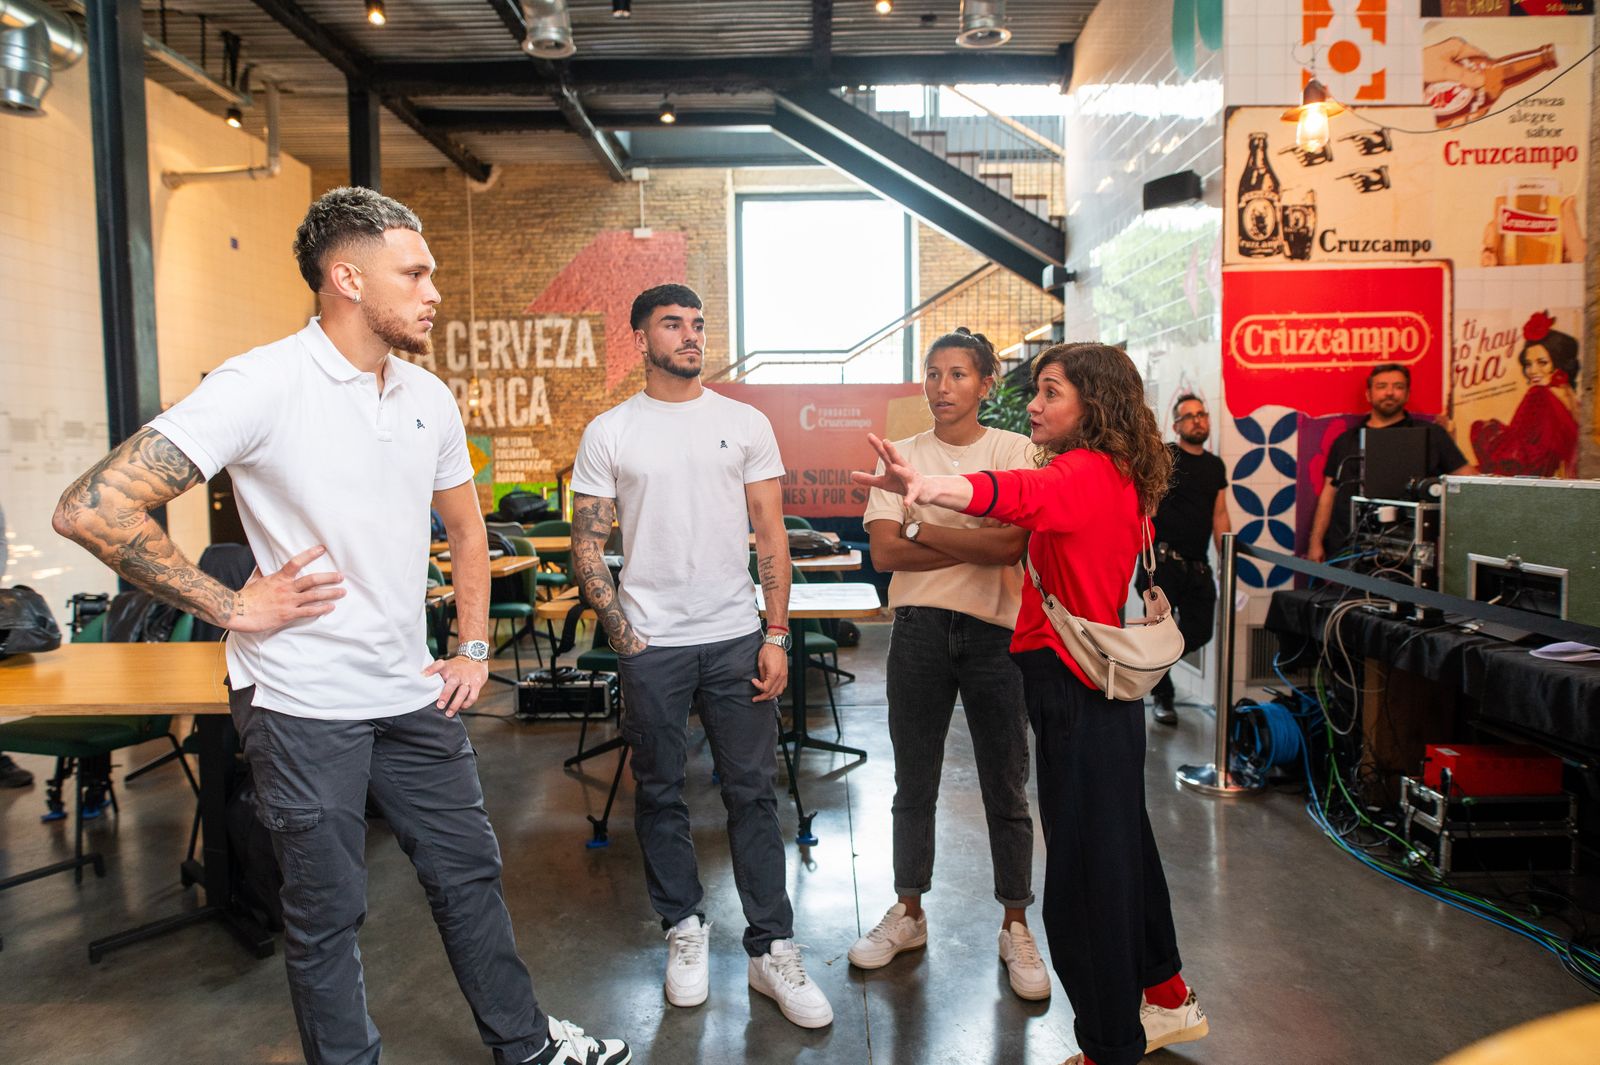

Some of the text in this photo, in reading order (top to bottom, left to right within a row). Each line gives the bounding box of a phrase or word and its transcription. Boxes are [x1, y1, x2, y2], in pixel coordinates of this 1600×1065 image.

[1508, 110, 1556, 125] alegre
[1525, 126, 1564, 138] sabor
[1443, 140, 1579, 170] Cruzcampo
[1319, 228, 1432, 257] Cruzcampo
[446, 317, 597, 372] CERVEZA
[1243, 324, 1420, 359] Cruzcampo
[1478, 327, 1521, 358] hay
[818, 417, 873, 428] Cruzcampo
[810, 487, 819, 504] Y
[822, 487, 846, 505] POR
